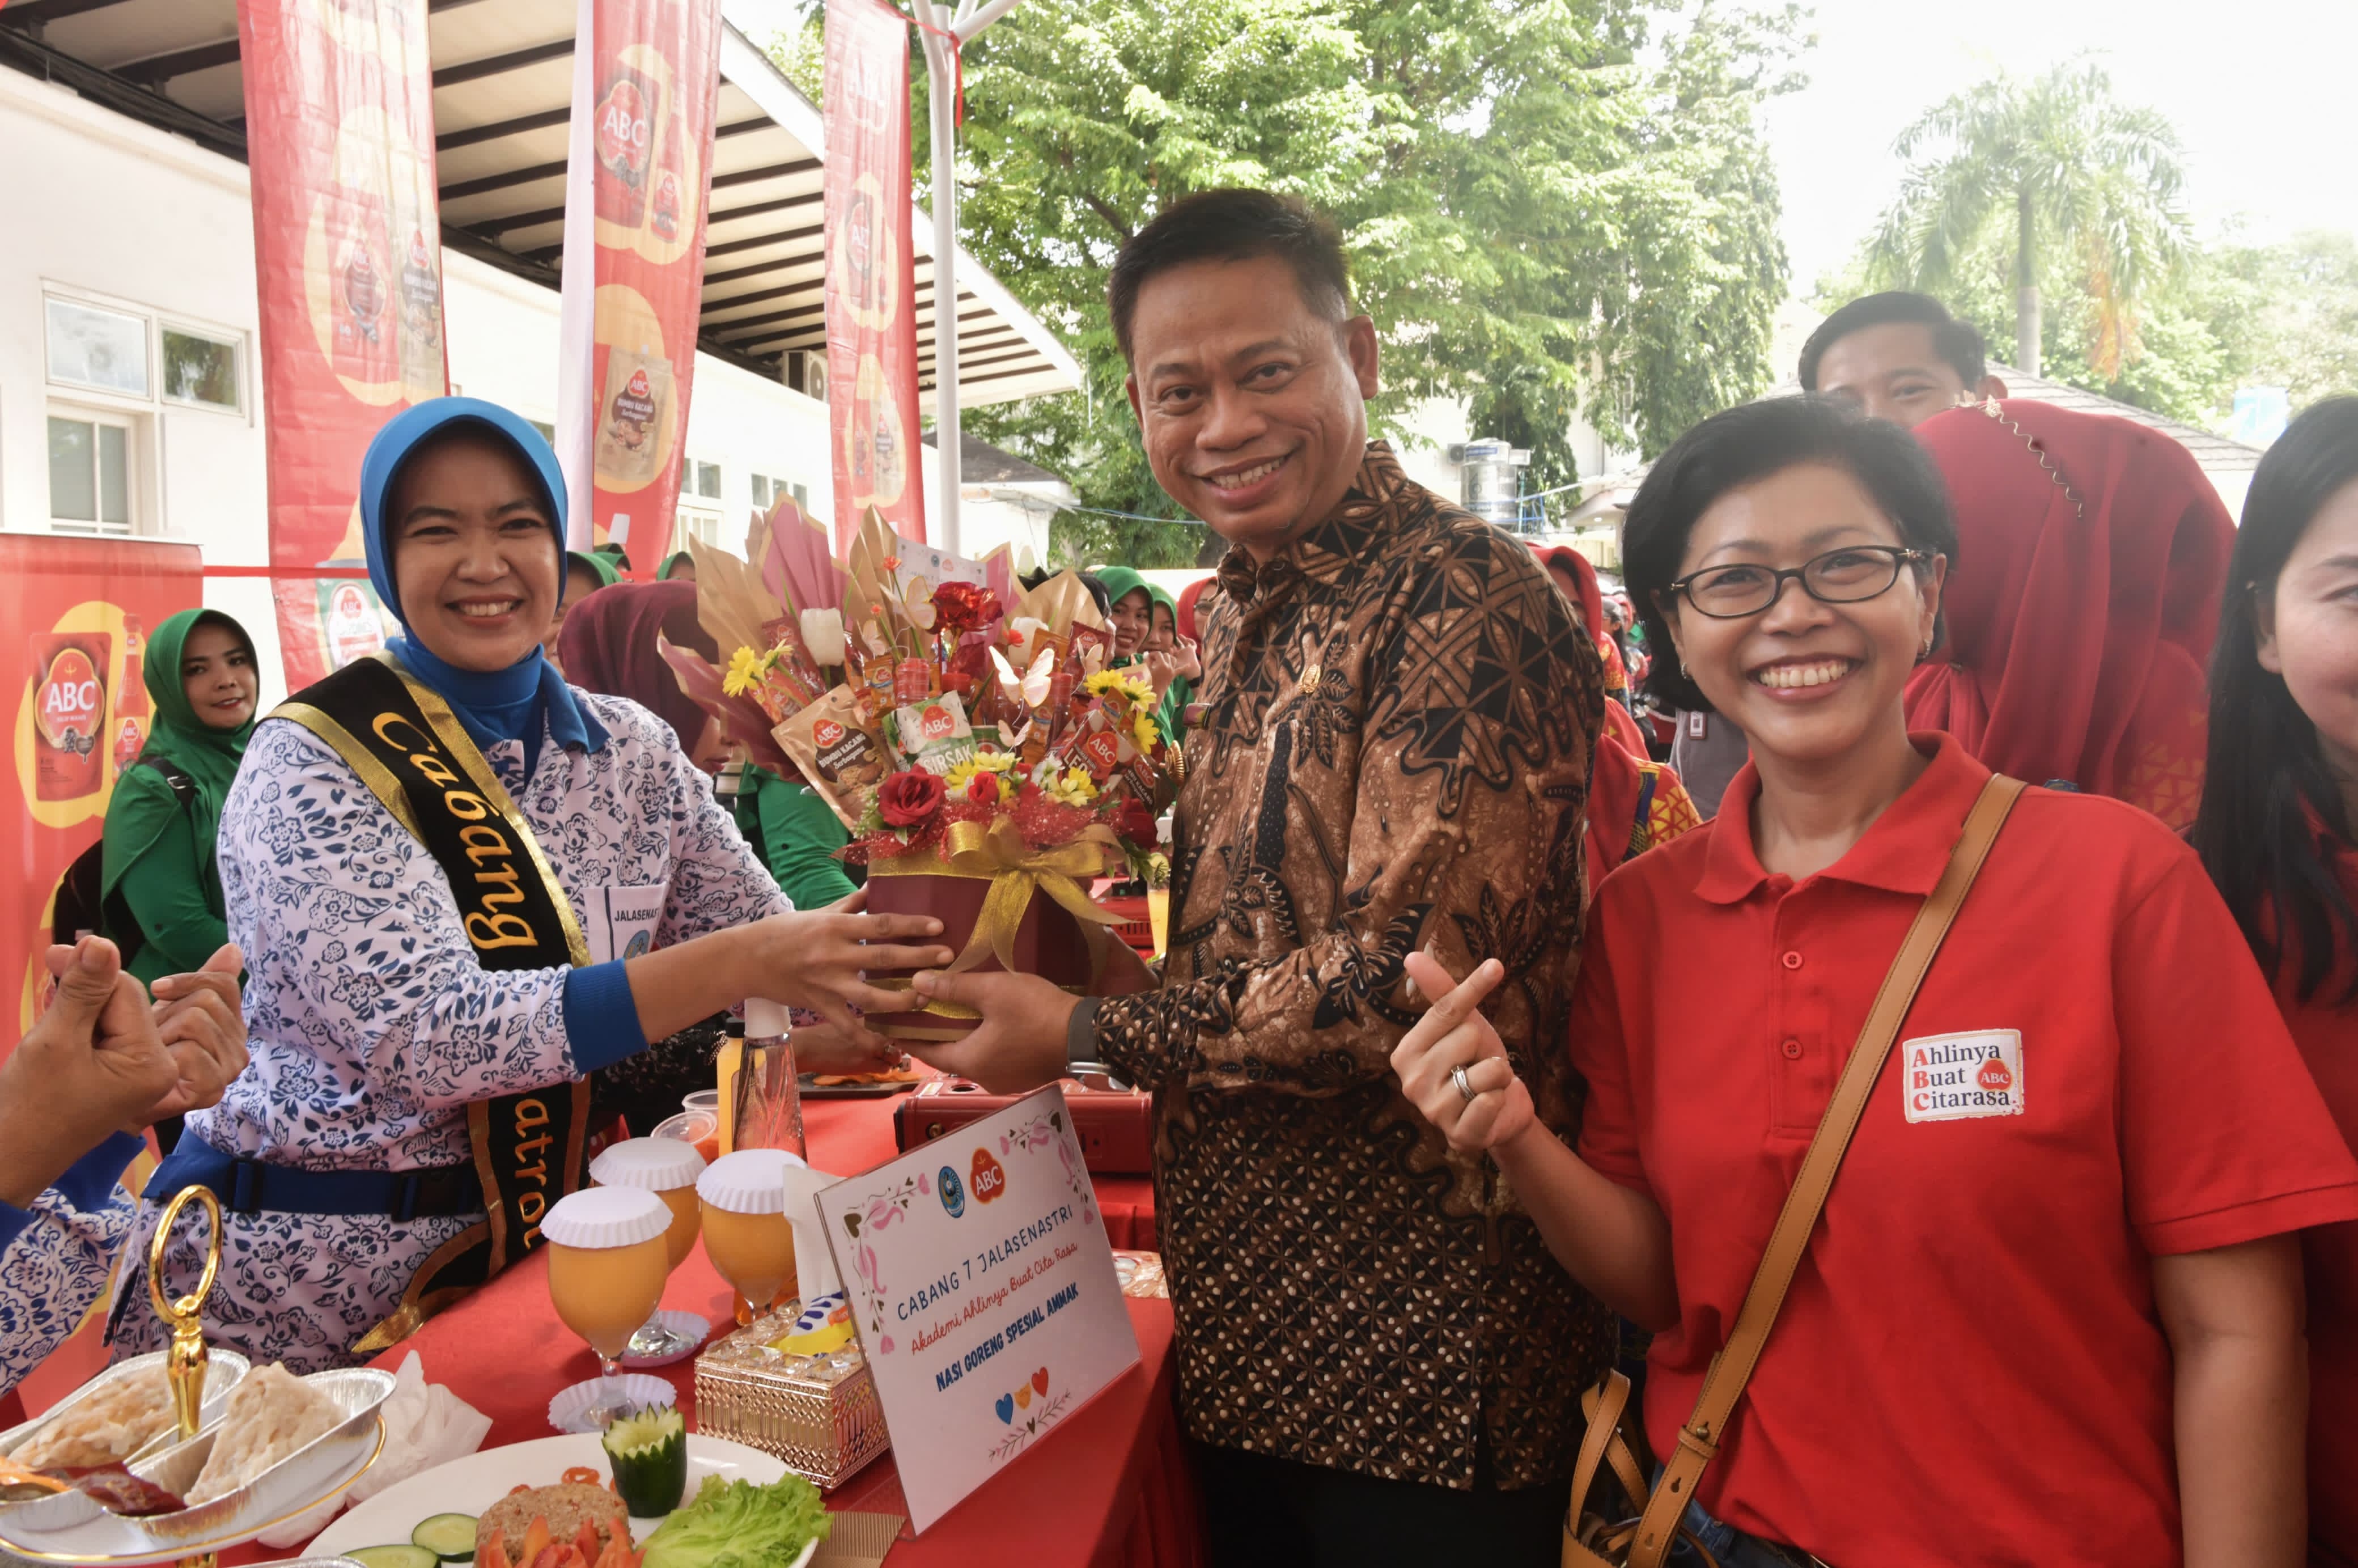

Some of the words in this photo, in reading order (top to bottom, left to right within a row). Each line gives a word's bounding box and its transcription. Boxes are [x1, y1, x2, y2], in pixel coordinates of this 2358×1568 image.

[603, 105, 645, 147] ABC
[630, 379, 647, 392] ABC
[45, 681, 95, 713] ABC
[817, 723, 841, 744] ABC
[925, 716, 952, 735] ABC
[923, 744, 974, 775] SIRSAK
[1090, 738, 1115, 762] ABC
[372, 711, 539, 950] Cabang
[1912, 1044, 2001, 1067] Ahlinya
[1913, 1067, 1966, 1089] Buat
[1980, 1073, 2009, 1084] ABC
[1913, 1091, 2010, 1112] Citarasa
[976, 1166, 1002, 1196] ABC
[898, 1272, 959, 1320] CABANG
[962, 1260, 971, 1280] 7
[977, 1204, 1072, 1272] JALASENASTRI
[911, 1313, 962, 1355] Akademi
[963, 1287, 1008, 1321] Ahlinya
[1010, 1266, 1034, 1291] Buat
[1034, 1256, 1055, 1274] Cita
[1054, 1242, 1078, 1261] Rasa
[935, 1361, 963, 1392] NASI
[964, 1333, 1004, 1372] GORENG
[1006, 1307, 1045, 1344] SPESIAL
[1047, 1281, 1079, 1316] AMMAK
